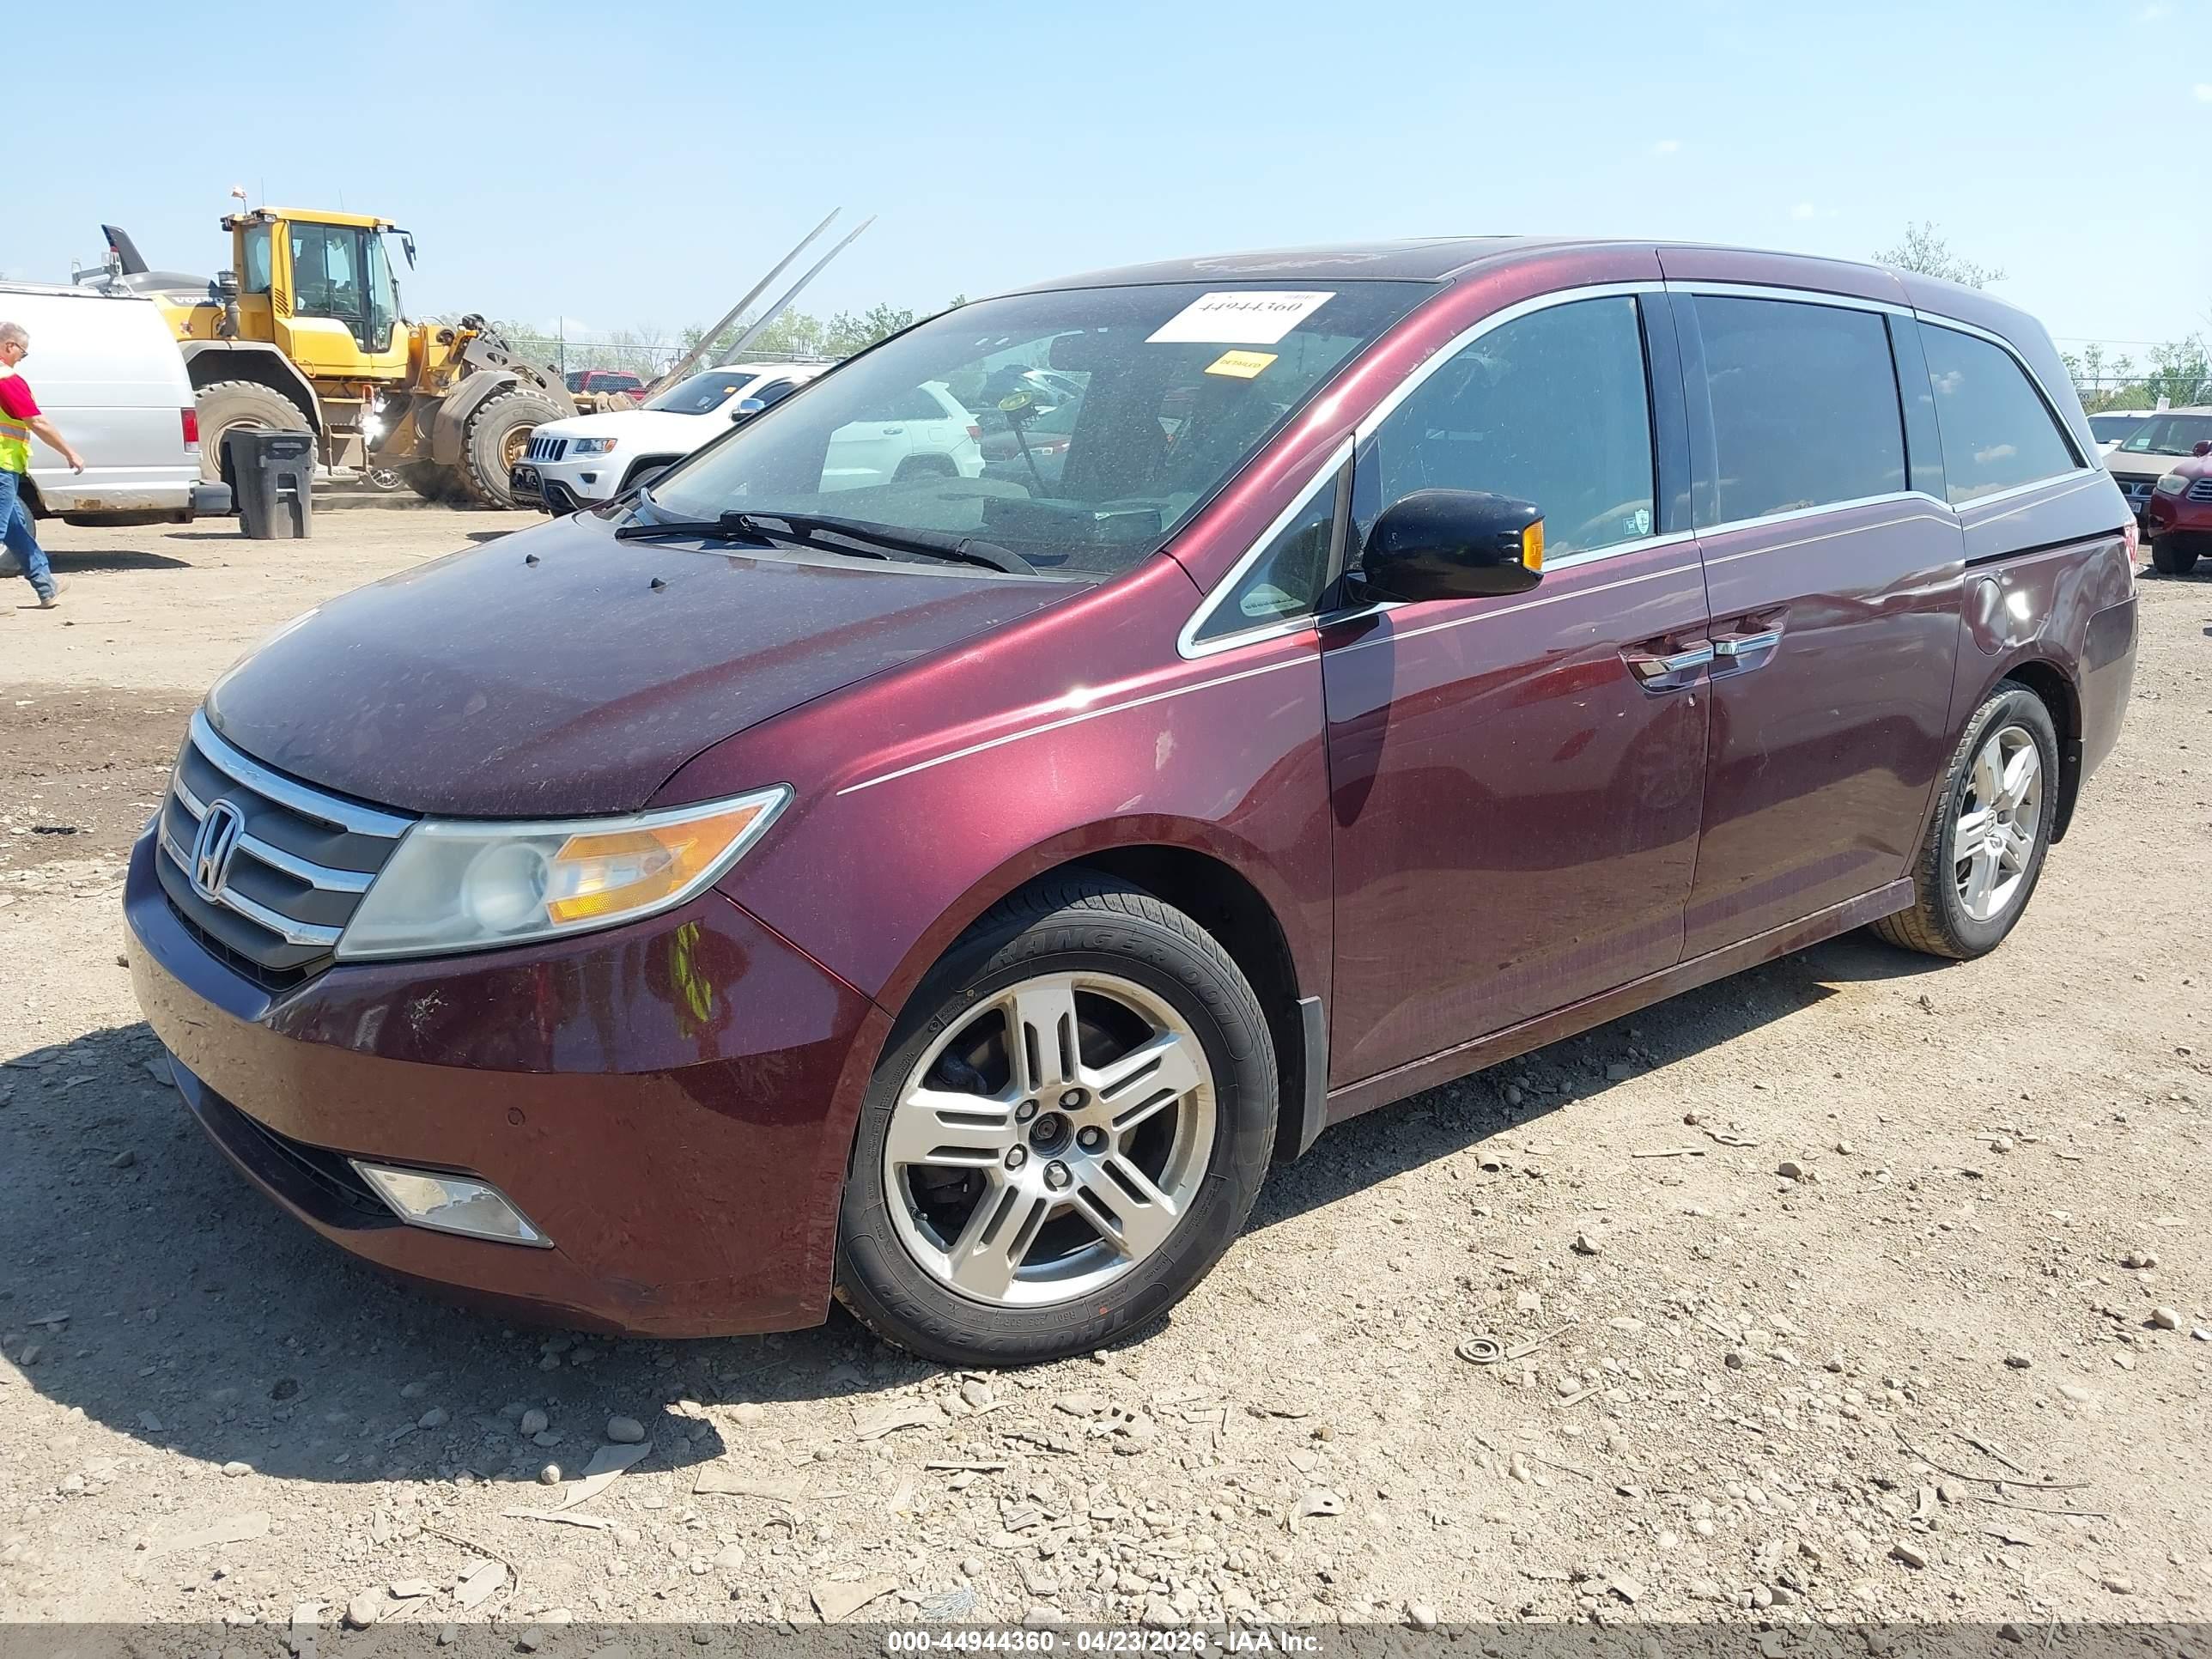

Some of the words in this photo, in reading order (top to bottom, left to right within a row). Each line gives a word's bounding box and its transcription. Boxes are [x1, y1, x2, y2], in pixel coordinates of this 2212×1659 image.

[1199, 301, 1303, 313] 44944360
[1220, 359, 1261, 368] DETAILED
[988, 927, 1170, 970] RANGER
[1179, 963, 1240, 1026] 007
